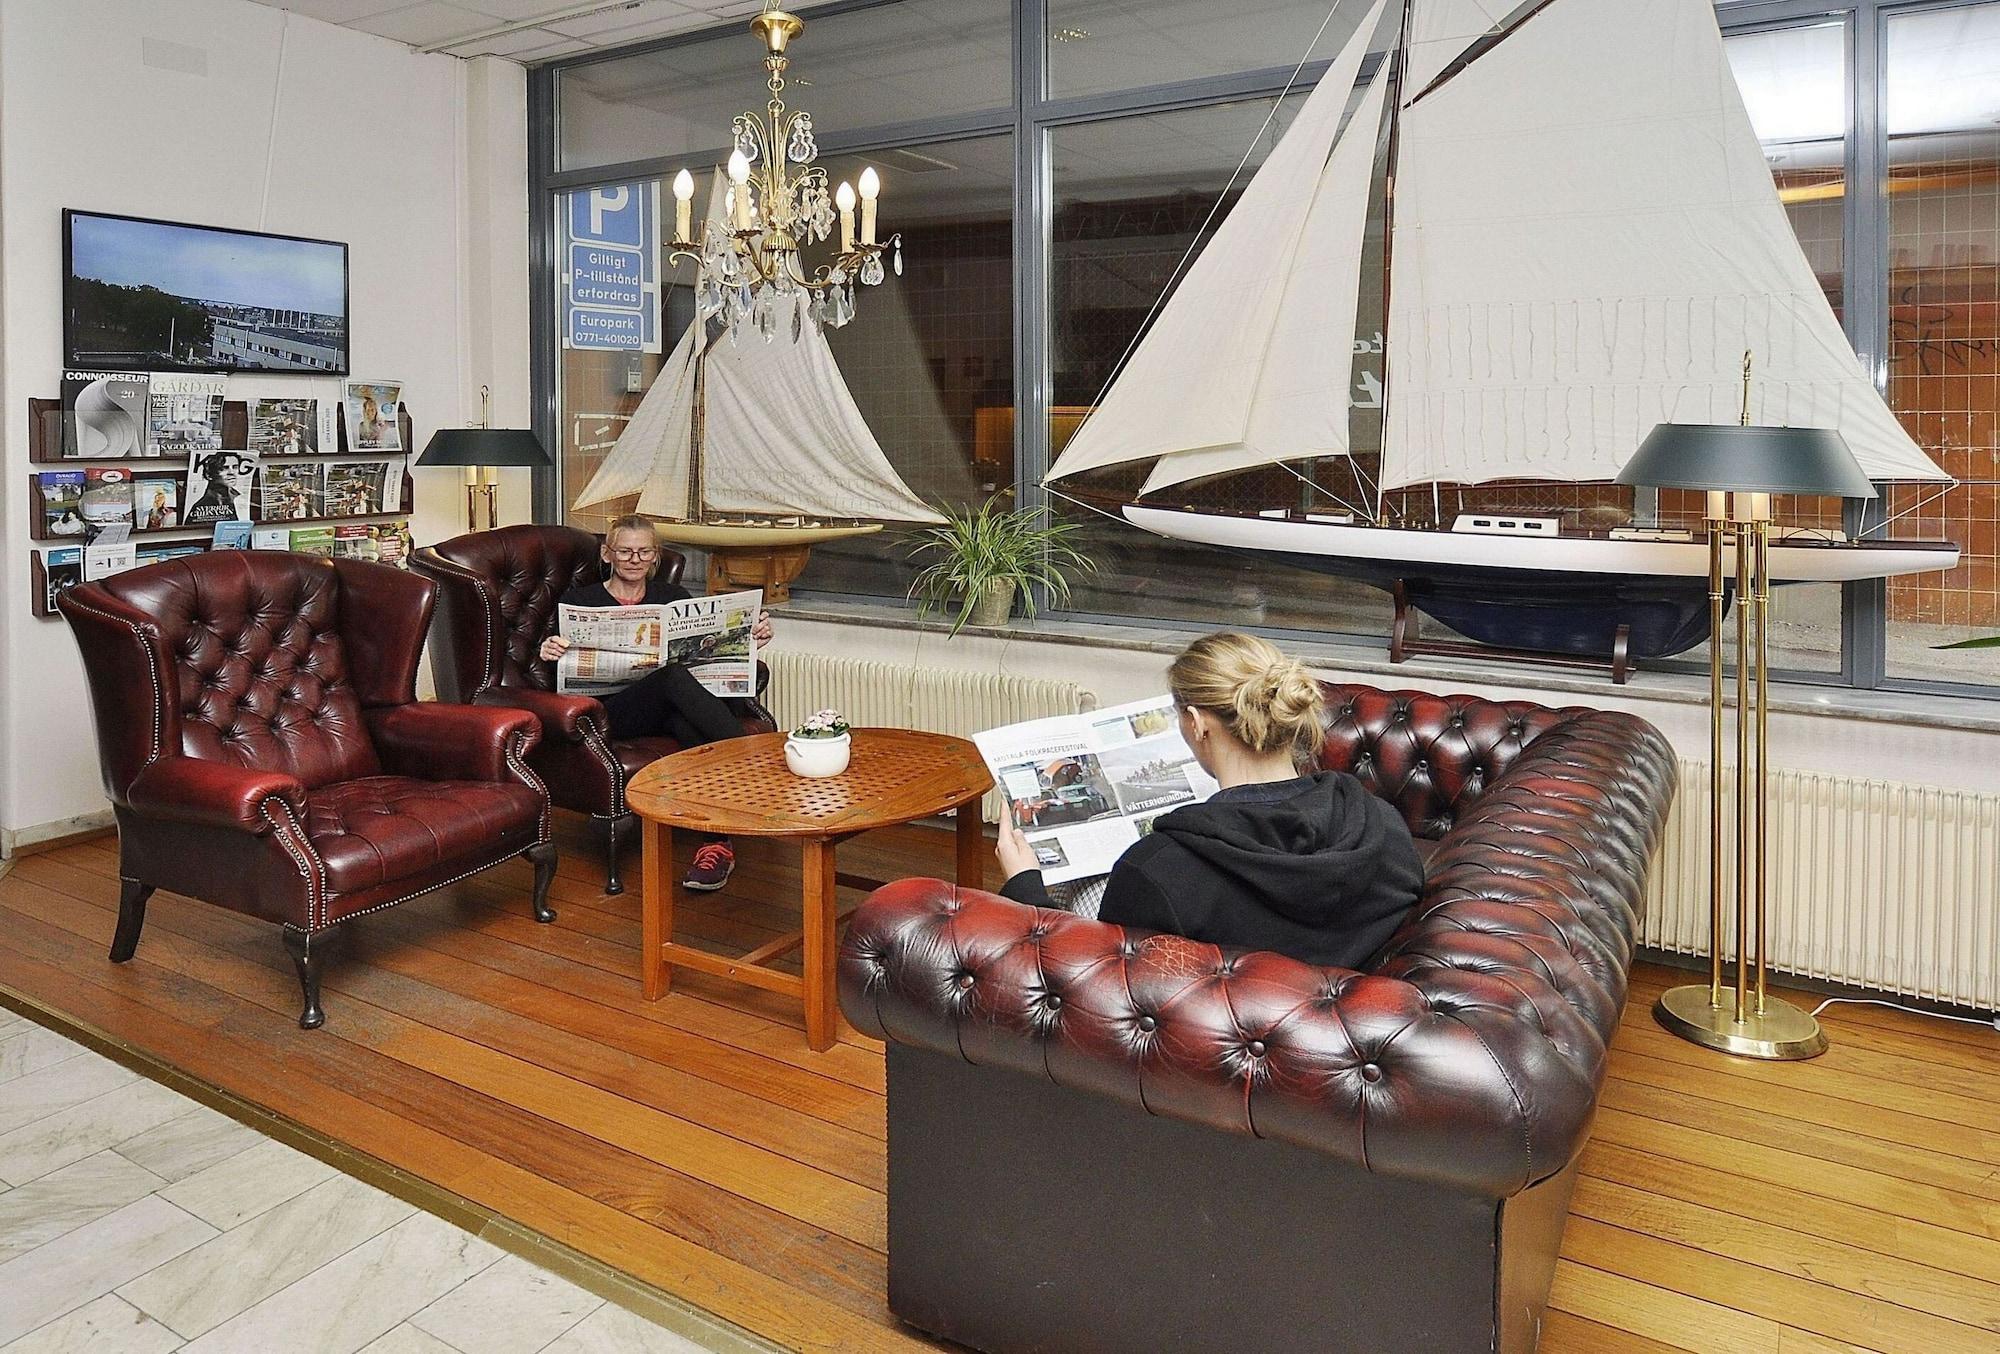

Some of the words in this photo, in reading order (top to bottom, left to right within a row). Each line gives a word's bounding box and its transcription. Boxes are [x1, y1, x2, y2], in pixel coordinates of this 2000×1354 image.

[591, 184, 629, 235] P
[589, 252, 626, 269] Giltigt
[575, 268, 639, 286] P-tillstånd
[577, 287, 637, 303] erfordras
[580, 315, 634, 329] Europark
[575, 332, 640, 345] 0771-401020
[66, 371, 149, 383] CONNOISSEUR
[121, 390, 135, 399] 20
